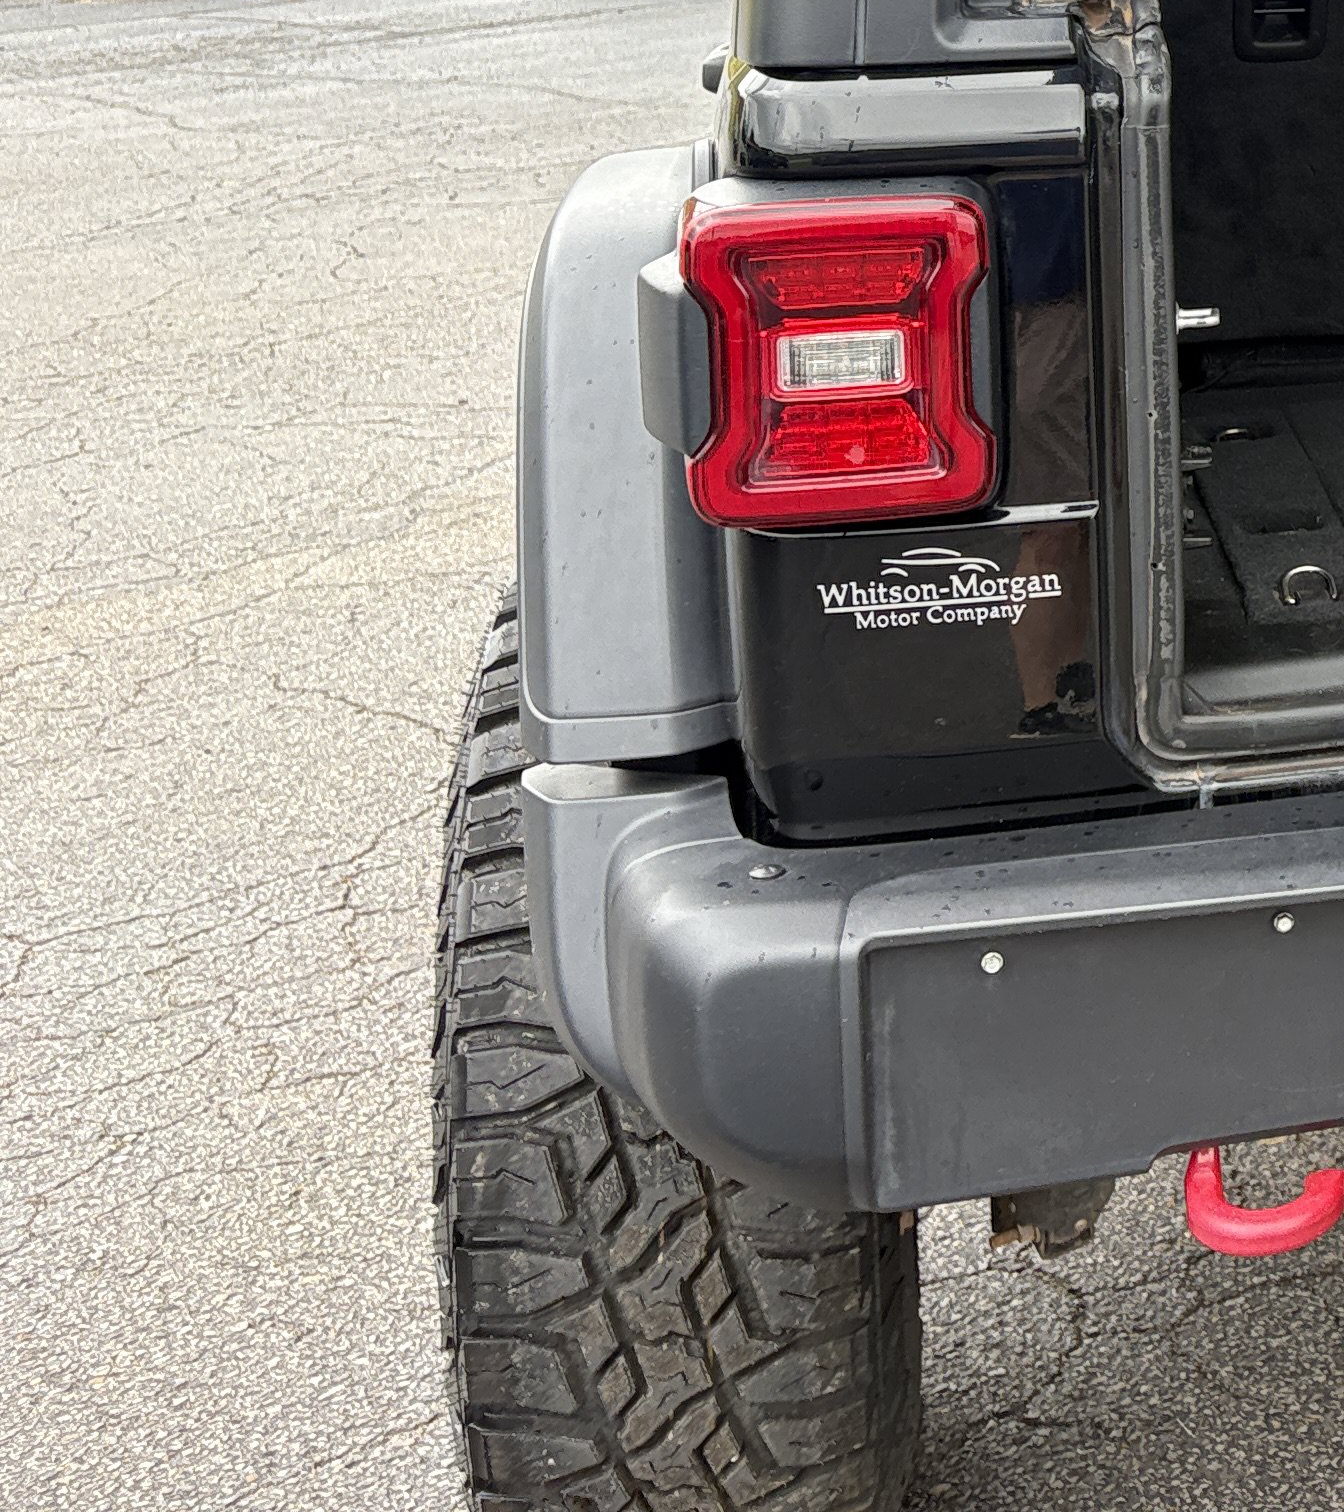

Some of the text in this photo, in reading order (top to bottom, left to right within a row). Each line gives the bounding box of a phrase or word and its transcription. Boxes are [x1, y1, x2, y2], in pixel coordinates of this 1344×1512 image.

[816, 573, 1062, 608] Whitson-Morgan
[854, 603, 1027, 630] Motor Company
